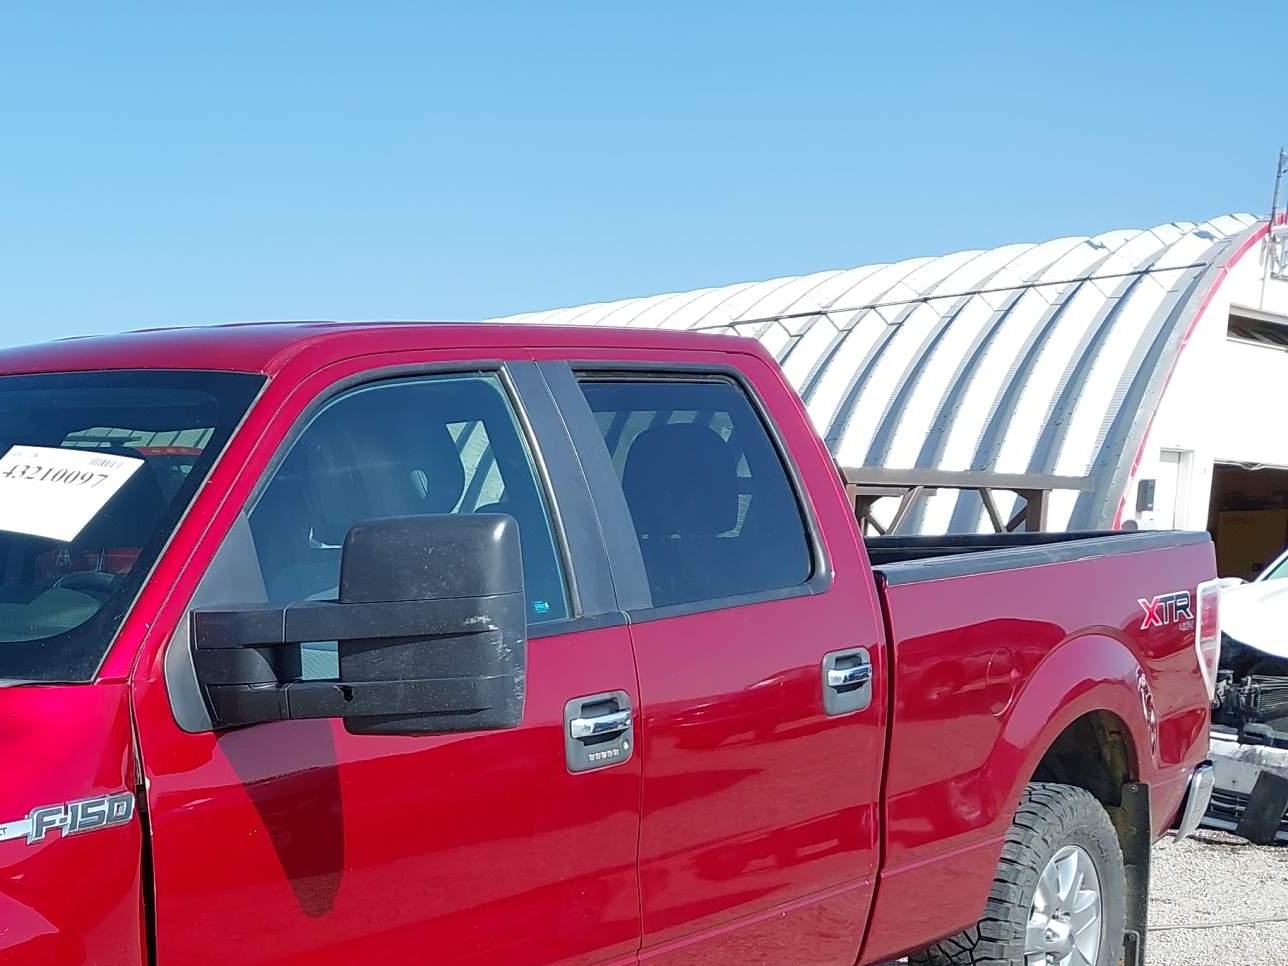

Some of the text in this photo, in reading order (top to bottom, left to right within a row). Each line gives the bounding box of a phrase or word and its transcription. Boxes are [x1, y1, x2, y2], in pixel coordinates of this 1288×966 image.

[2, 464, 109, 488] 43210097
[1137, 590, 1194, 630] XTR
[29, 792, 135, 843] F-150
